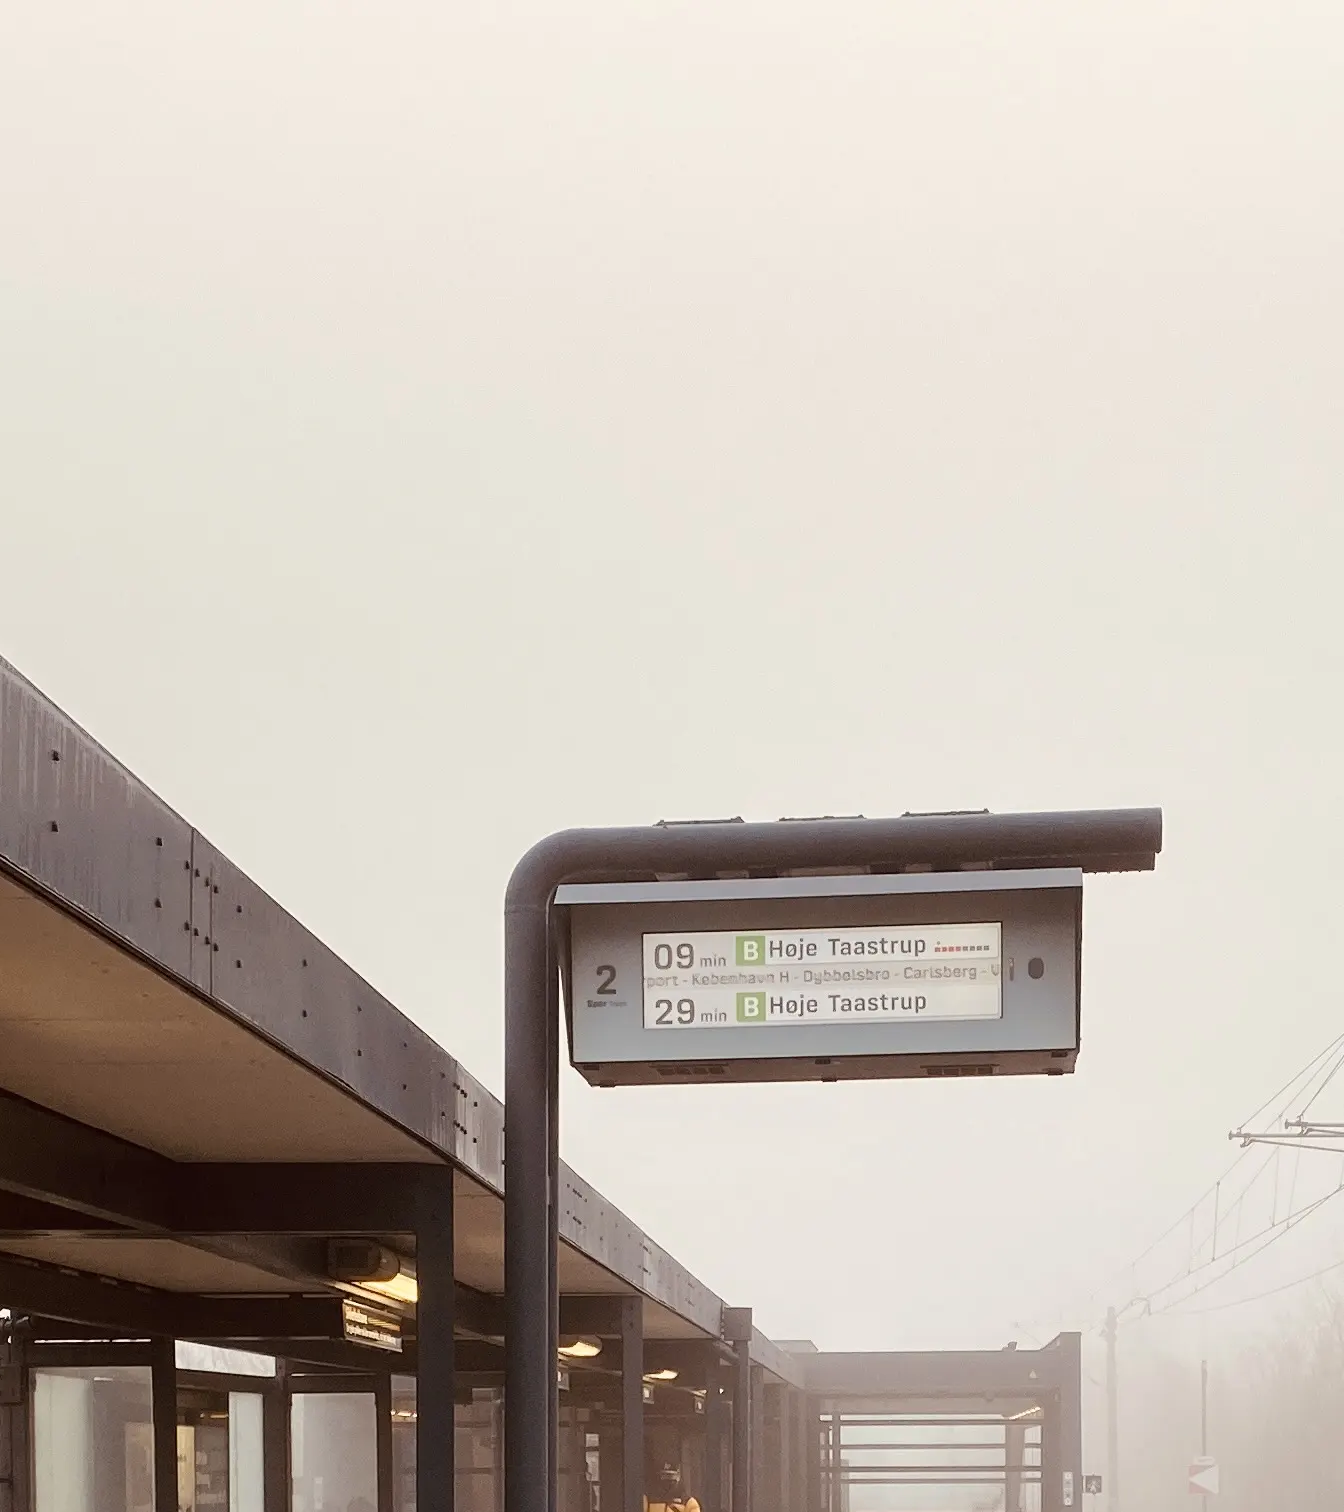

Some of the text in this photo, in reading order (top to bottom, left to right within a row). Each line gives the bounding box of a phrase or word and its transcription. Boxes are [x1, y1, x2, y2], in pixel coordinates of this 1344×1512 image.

[654, 937, 926, 970] 09 min B Høje Taastrup
[596, 965, 617, 995] 2
[642, 975, 679, 989] port
[779, 970, 790, 984] H
[655, 994, 927, 1025] 29 min B Høje Taastrup
